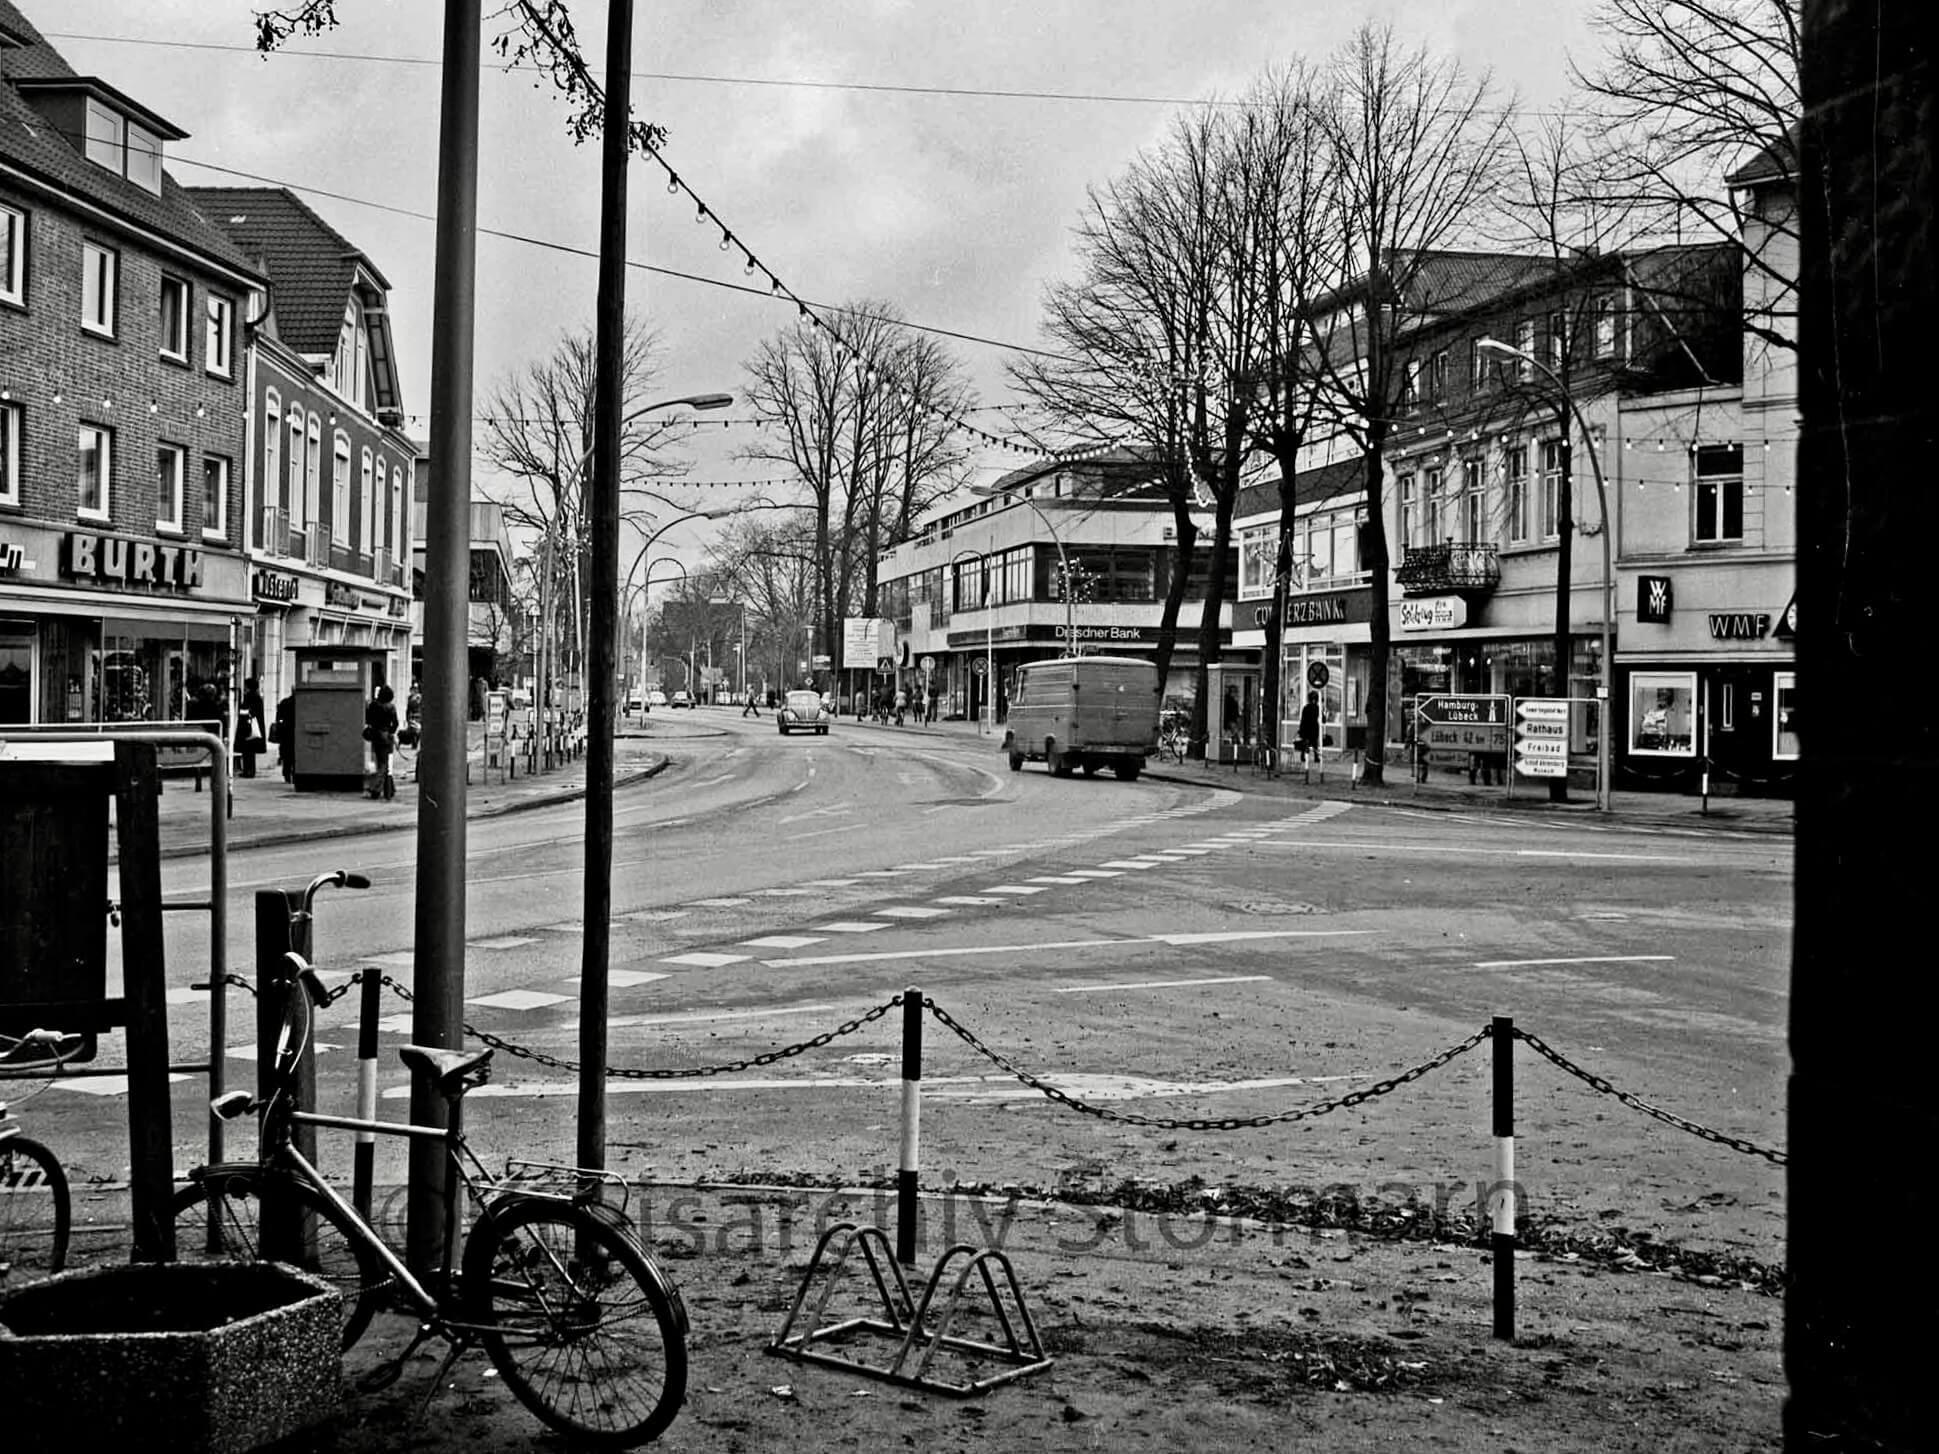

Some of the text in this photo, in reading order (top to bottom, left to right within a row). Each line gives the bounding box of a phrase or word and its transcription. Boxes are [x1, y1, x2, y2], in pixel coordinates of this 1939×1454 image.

[71, 533, 204, 587] BURTH
[1254, 597, 1343, 625] COERZBANK
[1709, 614, 1764, 637] WMF
[1110, 627, 1141, 639] Bank
[1448, 711, 1479, 721] Lübeck
[1527, 723, 1563, 734] Rathaus
[1431, 731, 1457, 743] Lübeck
[1493, 733, 1505, 745] 75
[1528, 743, 1561, 752] Freibad
